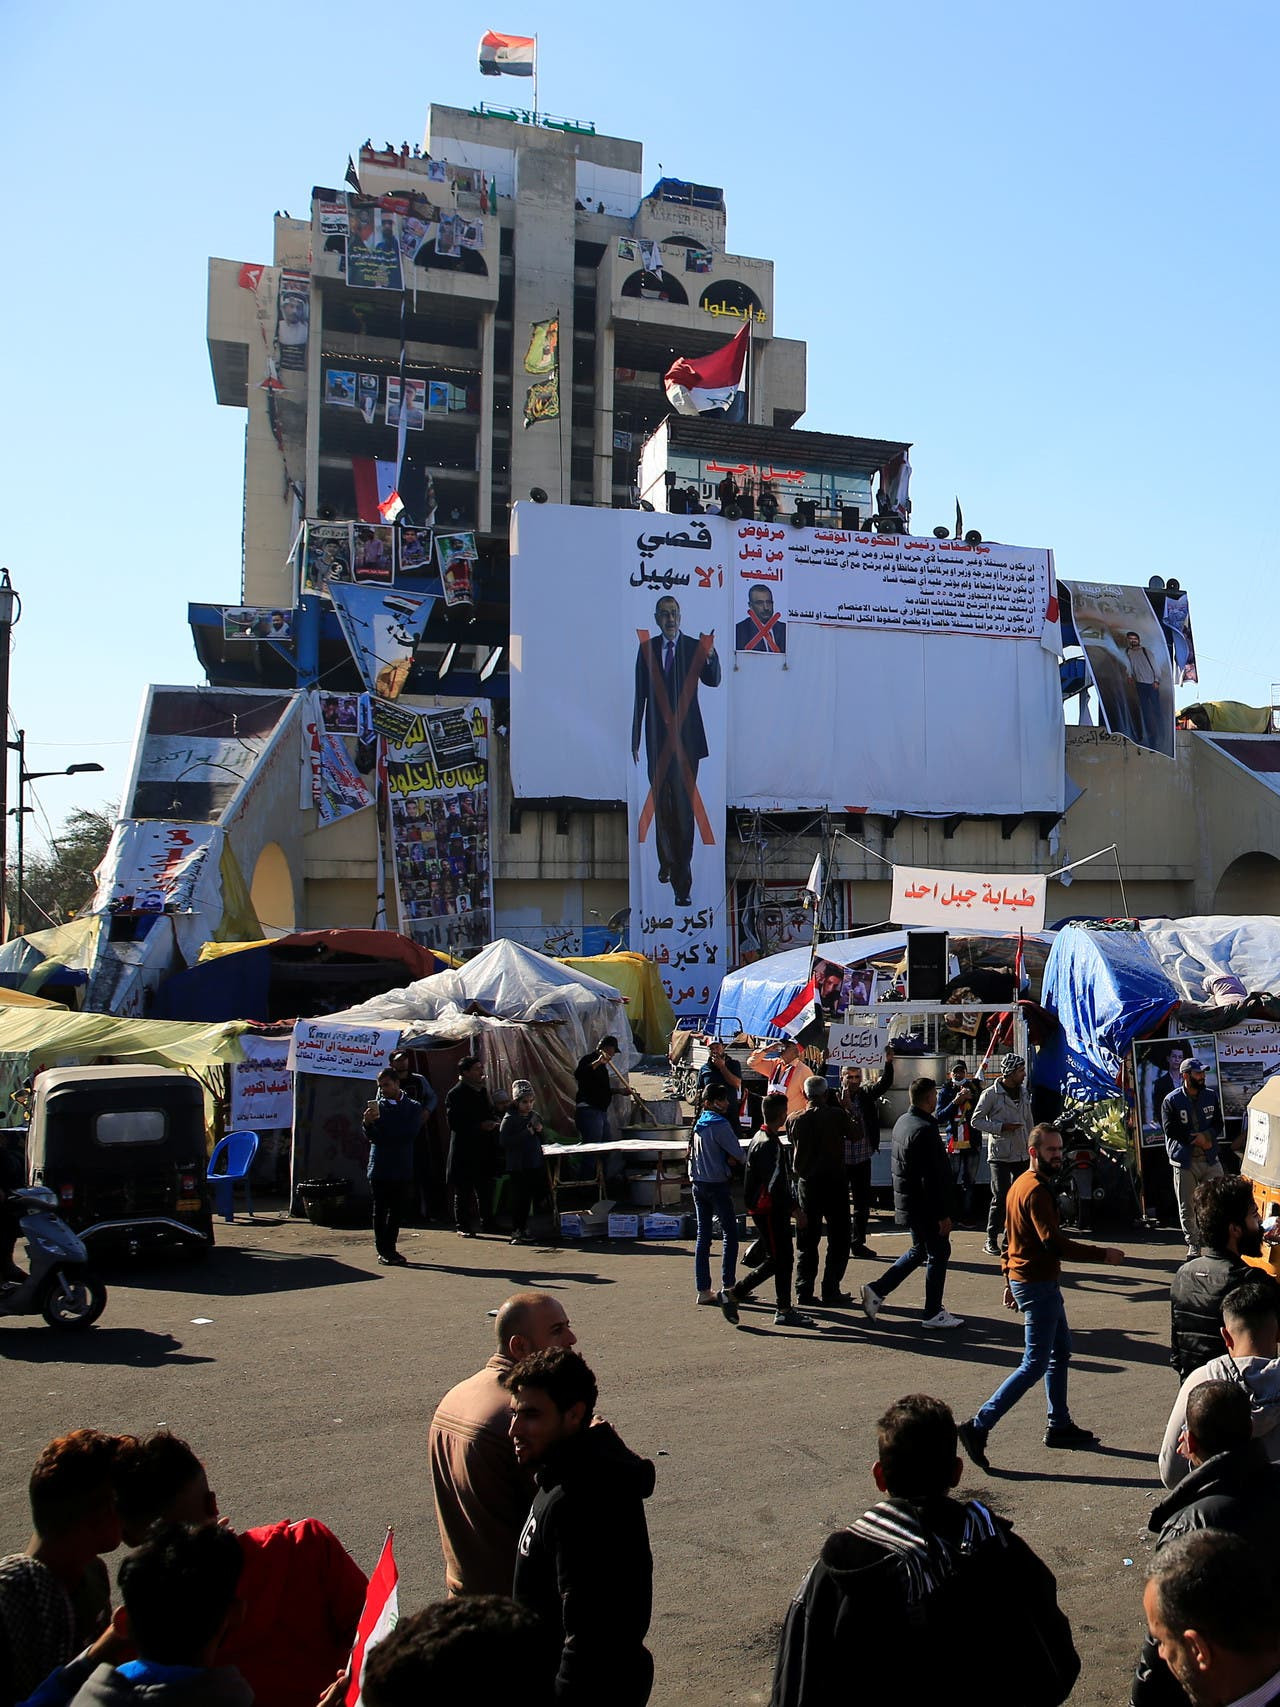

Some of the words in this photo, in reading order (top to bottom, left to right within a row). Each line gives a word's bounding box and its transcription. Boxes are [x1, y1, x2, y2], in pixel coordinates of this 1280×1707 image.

[703, 298, 753, 322] ارحلوا
[705, 459, 758, 475] احد
[761, 464, 807, 484] جبل
[637, 520, 712, 558] قصي
[738, 522, 785, 541] مرفوض
[814, 529, 852, 544] المؤقتة
[854, 533, 900, 547] الحكومة
[904, 539, 936, 552] رئيس
[738, 543, 763, 561] قبل
[765, 548, 784, 563] من
[938, 541, 991, 555] مواصفات
[794, 554, 822, 567] سياسية
[965, 558, 983, 568] وغير
[1009, 562, 1026, 571] يكون
[629, 560, 690, 591] سهيل
[740, 566, 784, 582] الشعب
[145, 749, 194, 764] اكبر
[389, 761, 441, 797] الخلود
[904, 881, 939, 899] احد
[940, 882, 977, 908] جبل
[982, 882, 1036, 912] طبابة
[677, 906, 714, 937] أكبر
[670, 941, 719, 972] لأكبر
[296, 1039, 325, 1050] التحرير
[325, 1040, 336, 1053] الى
[1224, 1045, 1245, 1056] عراق
[373, 1048, 385, 1058] من
[1180, 1109, 1188, 1124] 9
